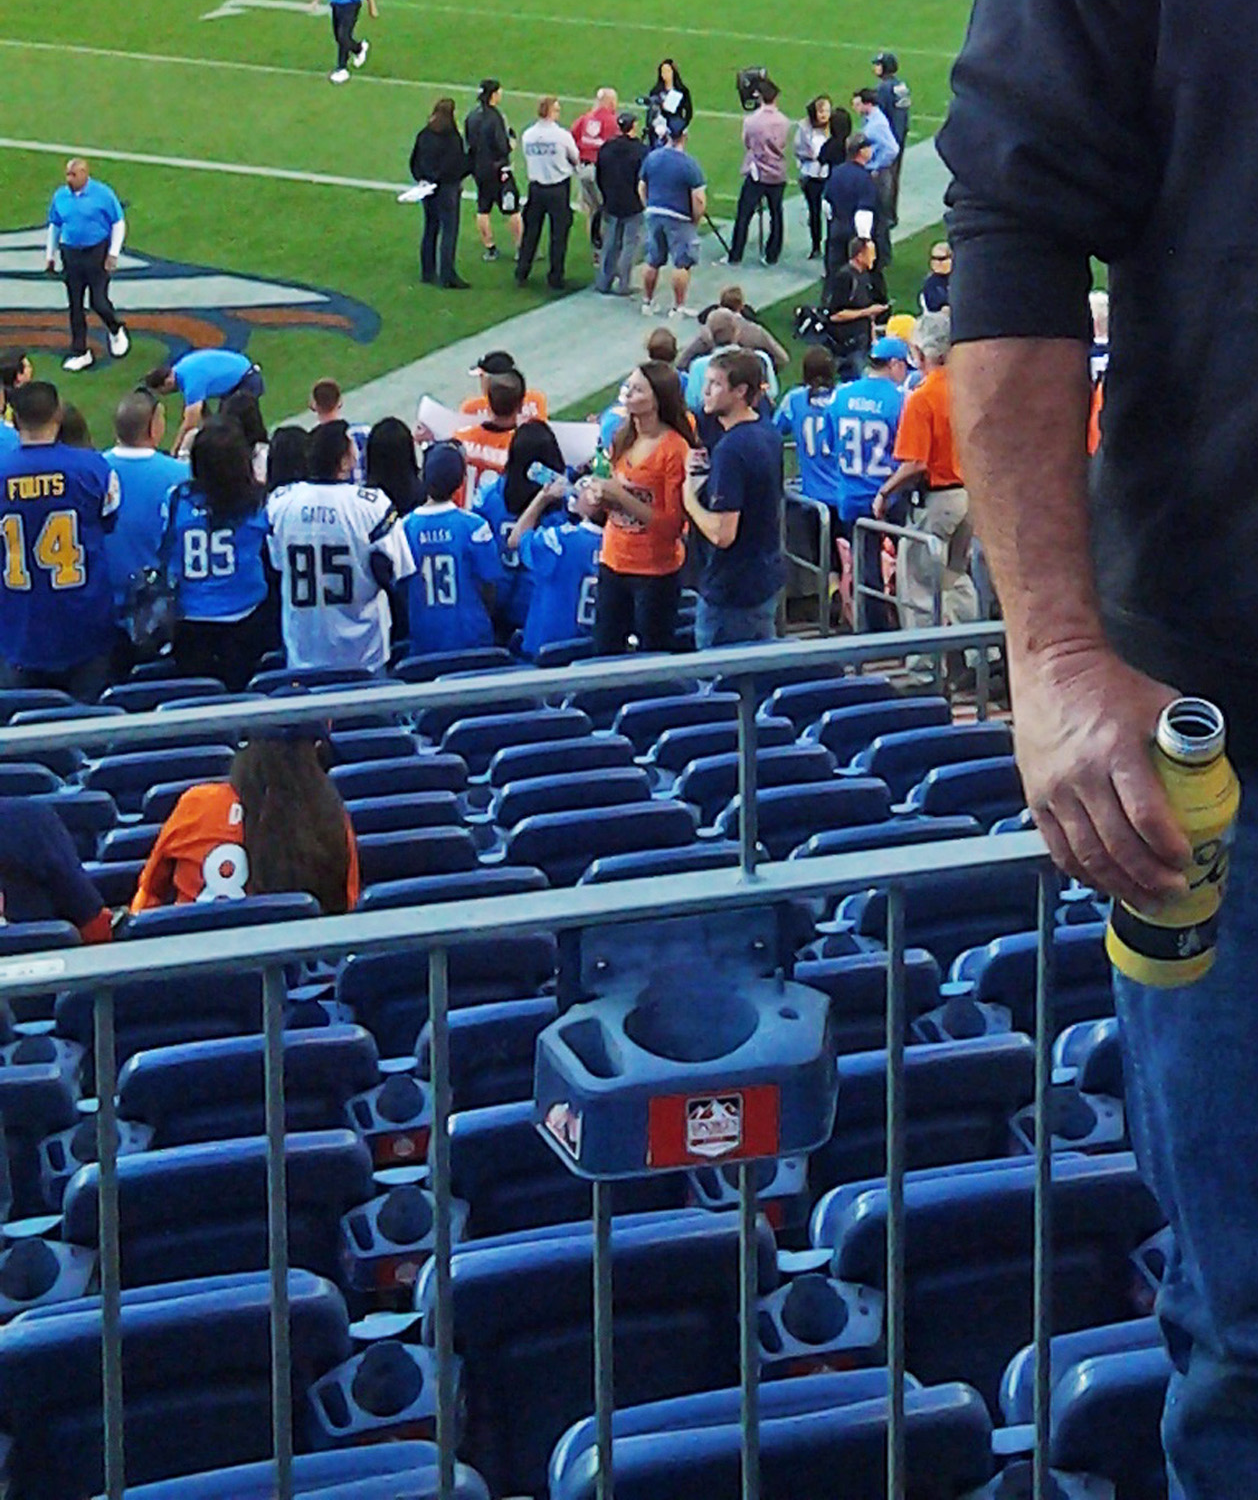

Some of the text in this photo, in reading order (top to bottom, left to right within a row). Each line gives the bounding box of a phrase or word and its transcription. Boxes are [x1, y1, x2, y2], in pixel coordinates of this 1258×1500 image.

[838, 416, 893, 476] 32
[7, 473, 65, 501] FOUTS
[0, 508, 86, 591] 14
[183, 528, 236, 581] 85
[286, 543, 355, 609] 85
[421, 553, 457, 607] 13
